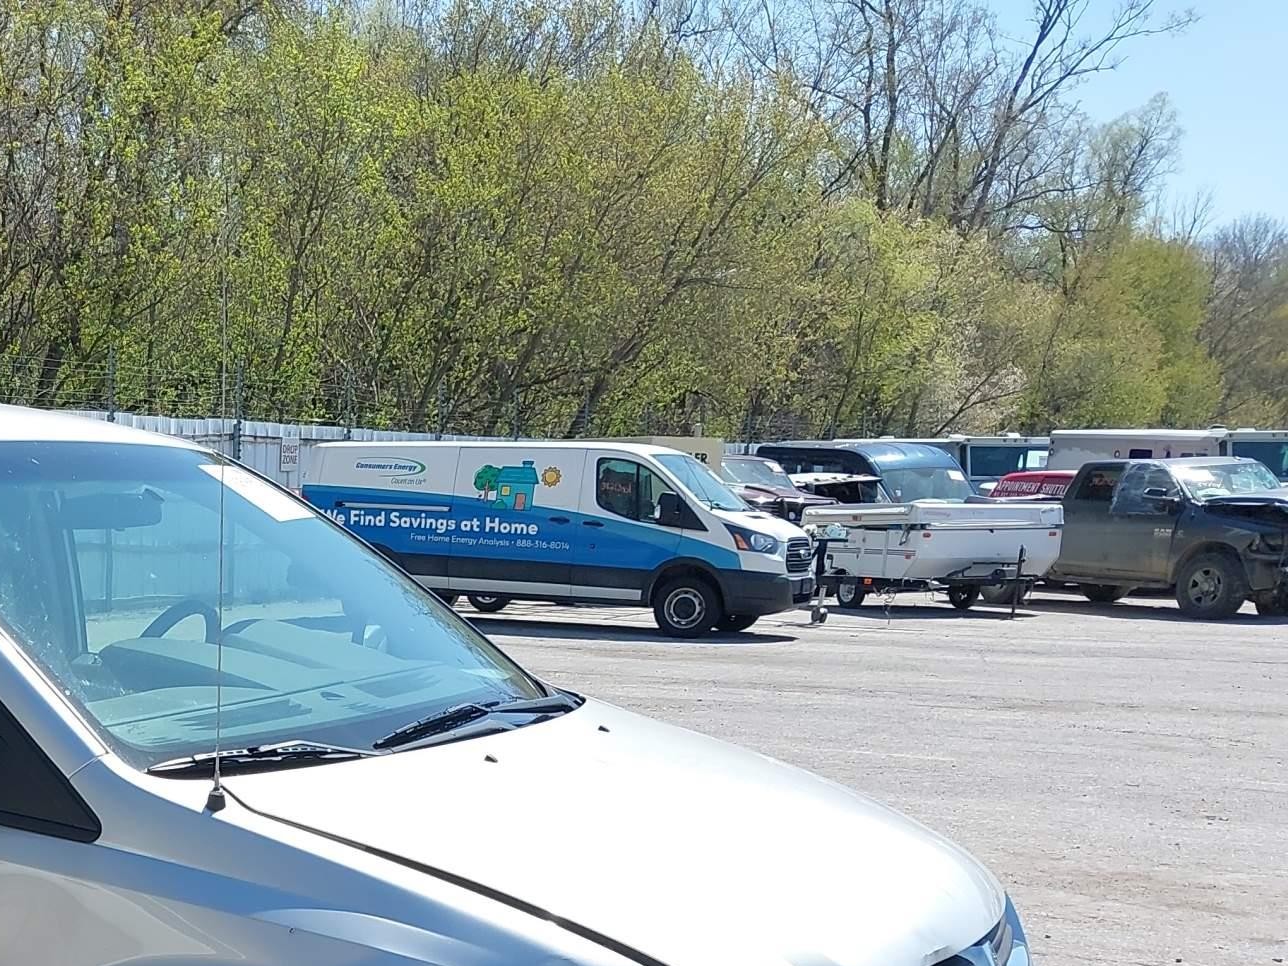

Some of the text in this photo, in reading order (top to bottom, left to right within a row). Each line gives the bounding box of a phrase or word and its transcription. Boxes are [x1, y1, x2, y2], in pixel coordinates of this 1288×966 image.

[282, 444, 298, 454] DROP
[282, 455, 298, 464] ZONE
[355, 462, 417, 472] Consumers Energy
[391, 477, 406, 485] Count
[996, 479, 1040, 494] APPOINTMENT
[350, 511, 384, 526] Find
[389, 512, 456, 533] Savings
[460, 520, 480, 533] at
[485, 517, 539, 535] Home
[410, 532, 426, 541] Free
[427, 535, 450, 543] Home
[452, 535, 477, 545] Energy
[478, 537, 510, 547] Analysis
